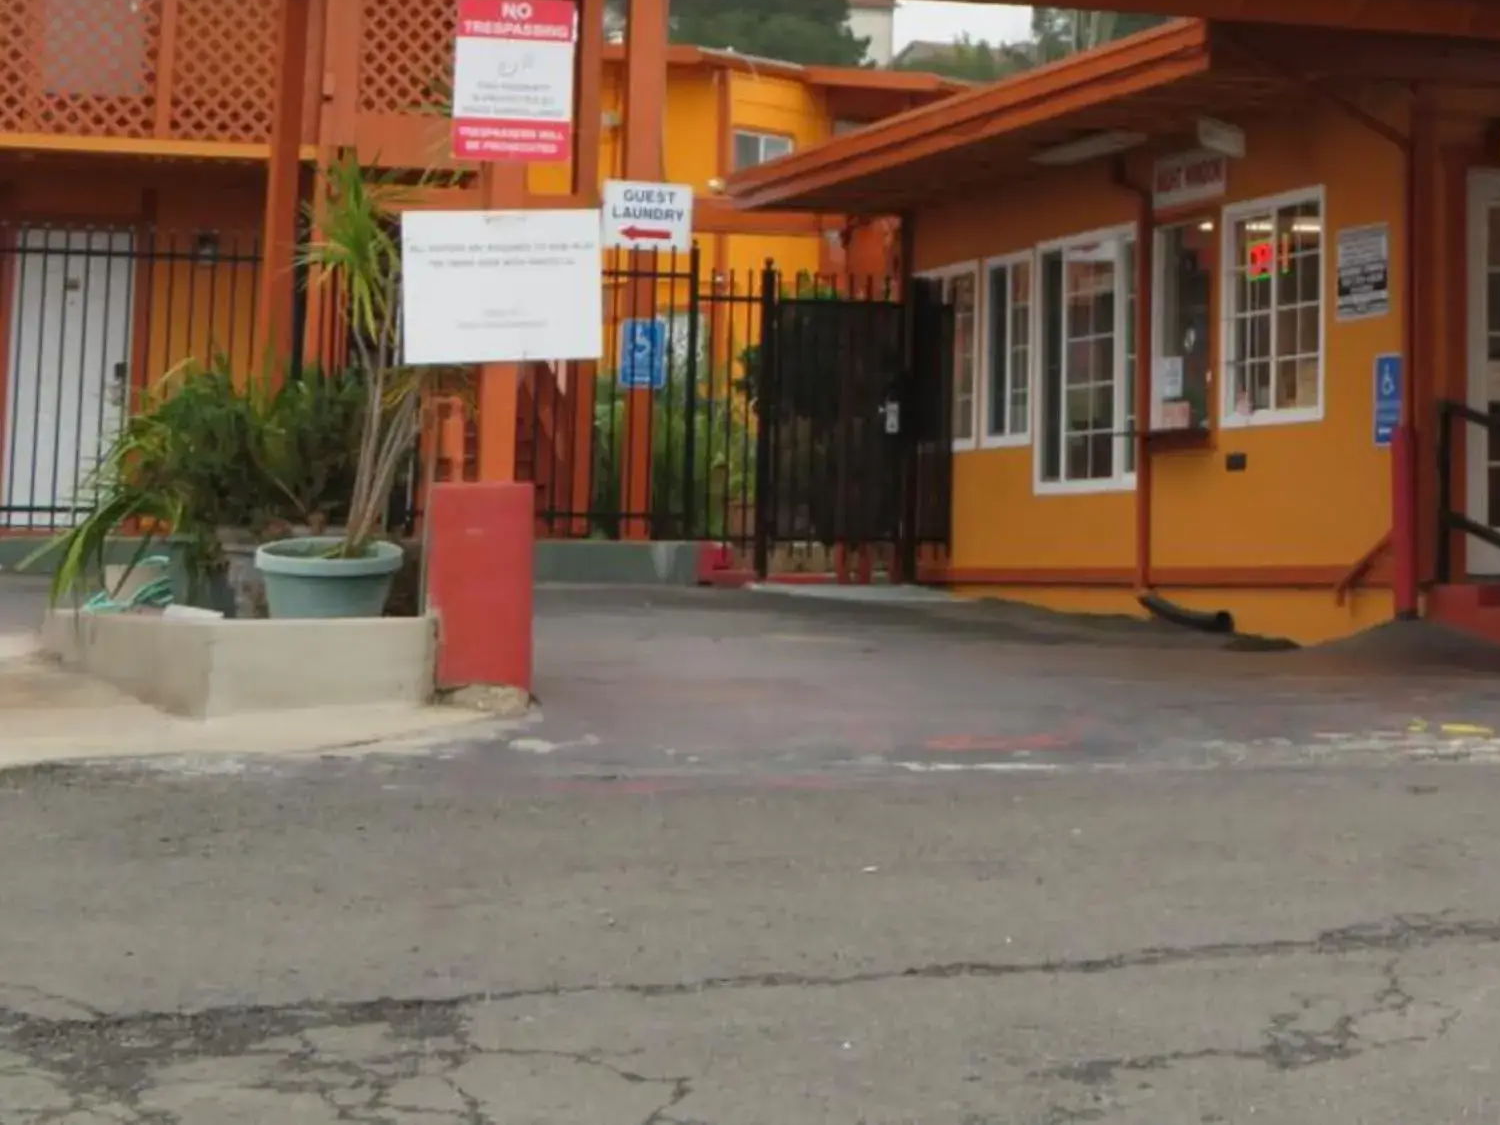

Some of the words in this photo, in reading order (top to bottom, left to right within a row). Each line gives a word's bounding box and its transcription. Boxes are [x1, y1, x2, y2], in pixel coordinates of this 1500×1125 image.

[501, 2, 532, 20] NO
[463, 20, 570, 38] TRESPASSING
[623, 189, 676, 204] GUEST
[612, 204, 684, 222] LAUNDRY
